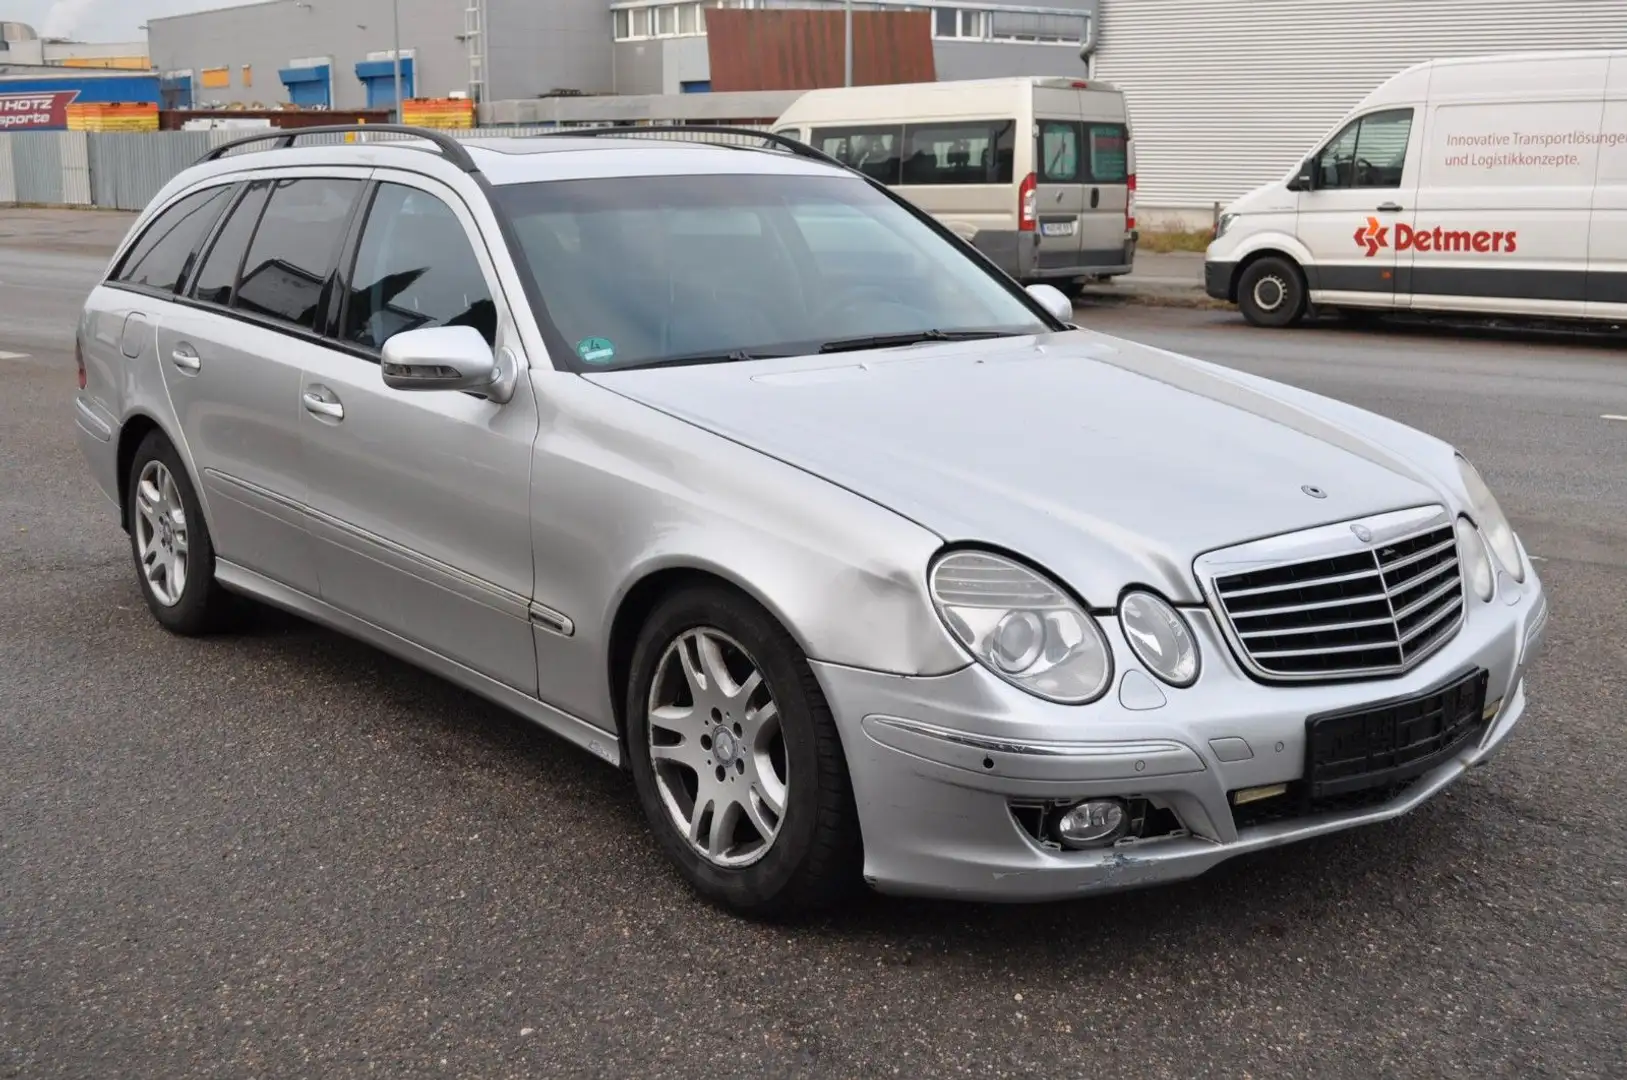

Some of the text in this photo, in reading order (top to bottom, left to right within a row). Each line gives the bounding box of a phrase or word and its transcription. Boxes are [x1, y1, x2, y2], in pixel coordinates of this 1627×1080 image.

[4, 99, 53, 111] HOTZ
[1446, 130, 1627, 148] Innovative Transportlösunge
[1445, 152, 1580, 169] und Logistikkonzepte.
[1395, 223, 1517, 253] Detmers
